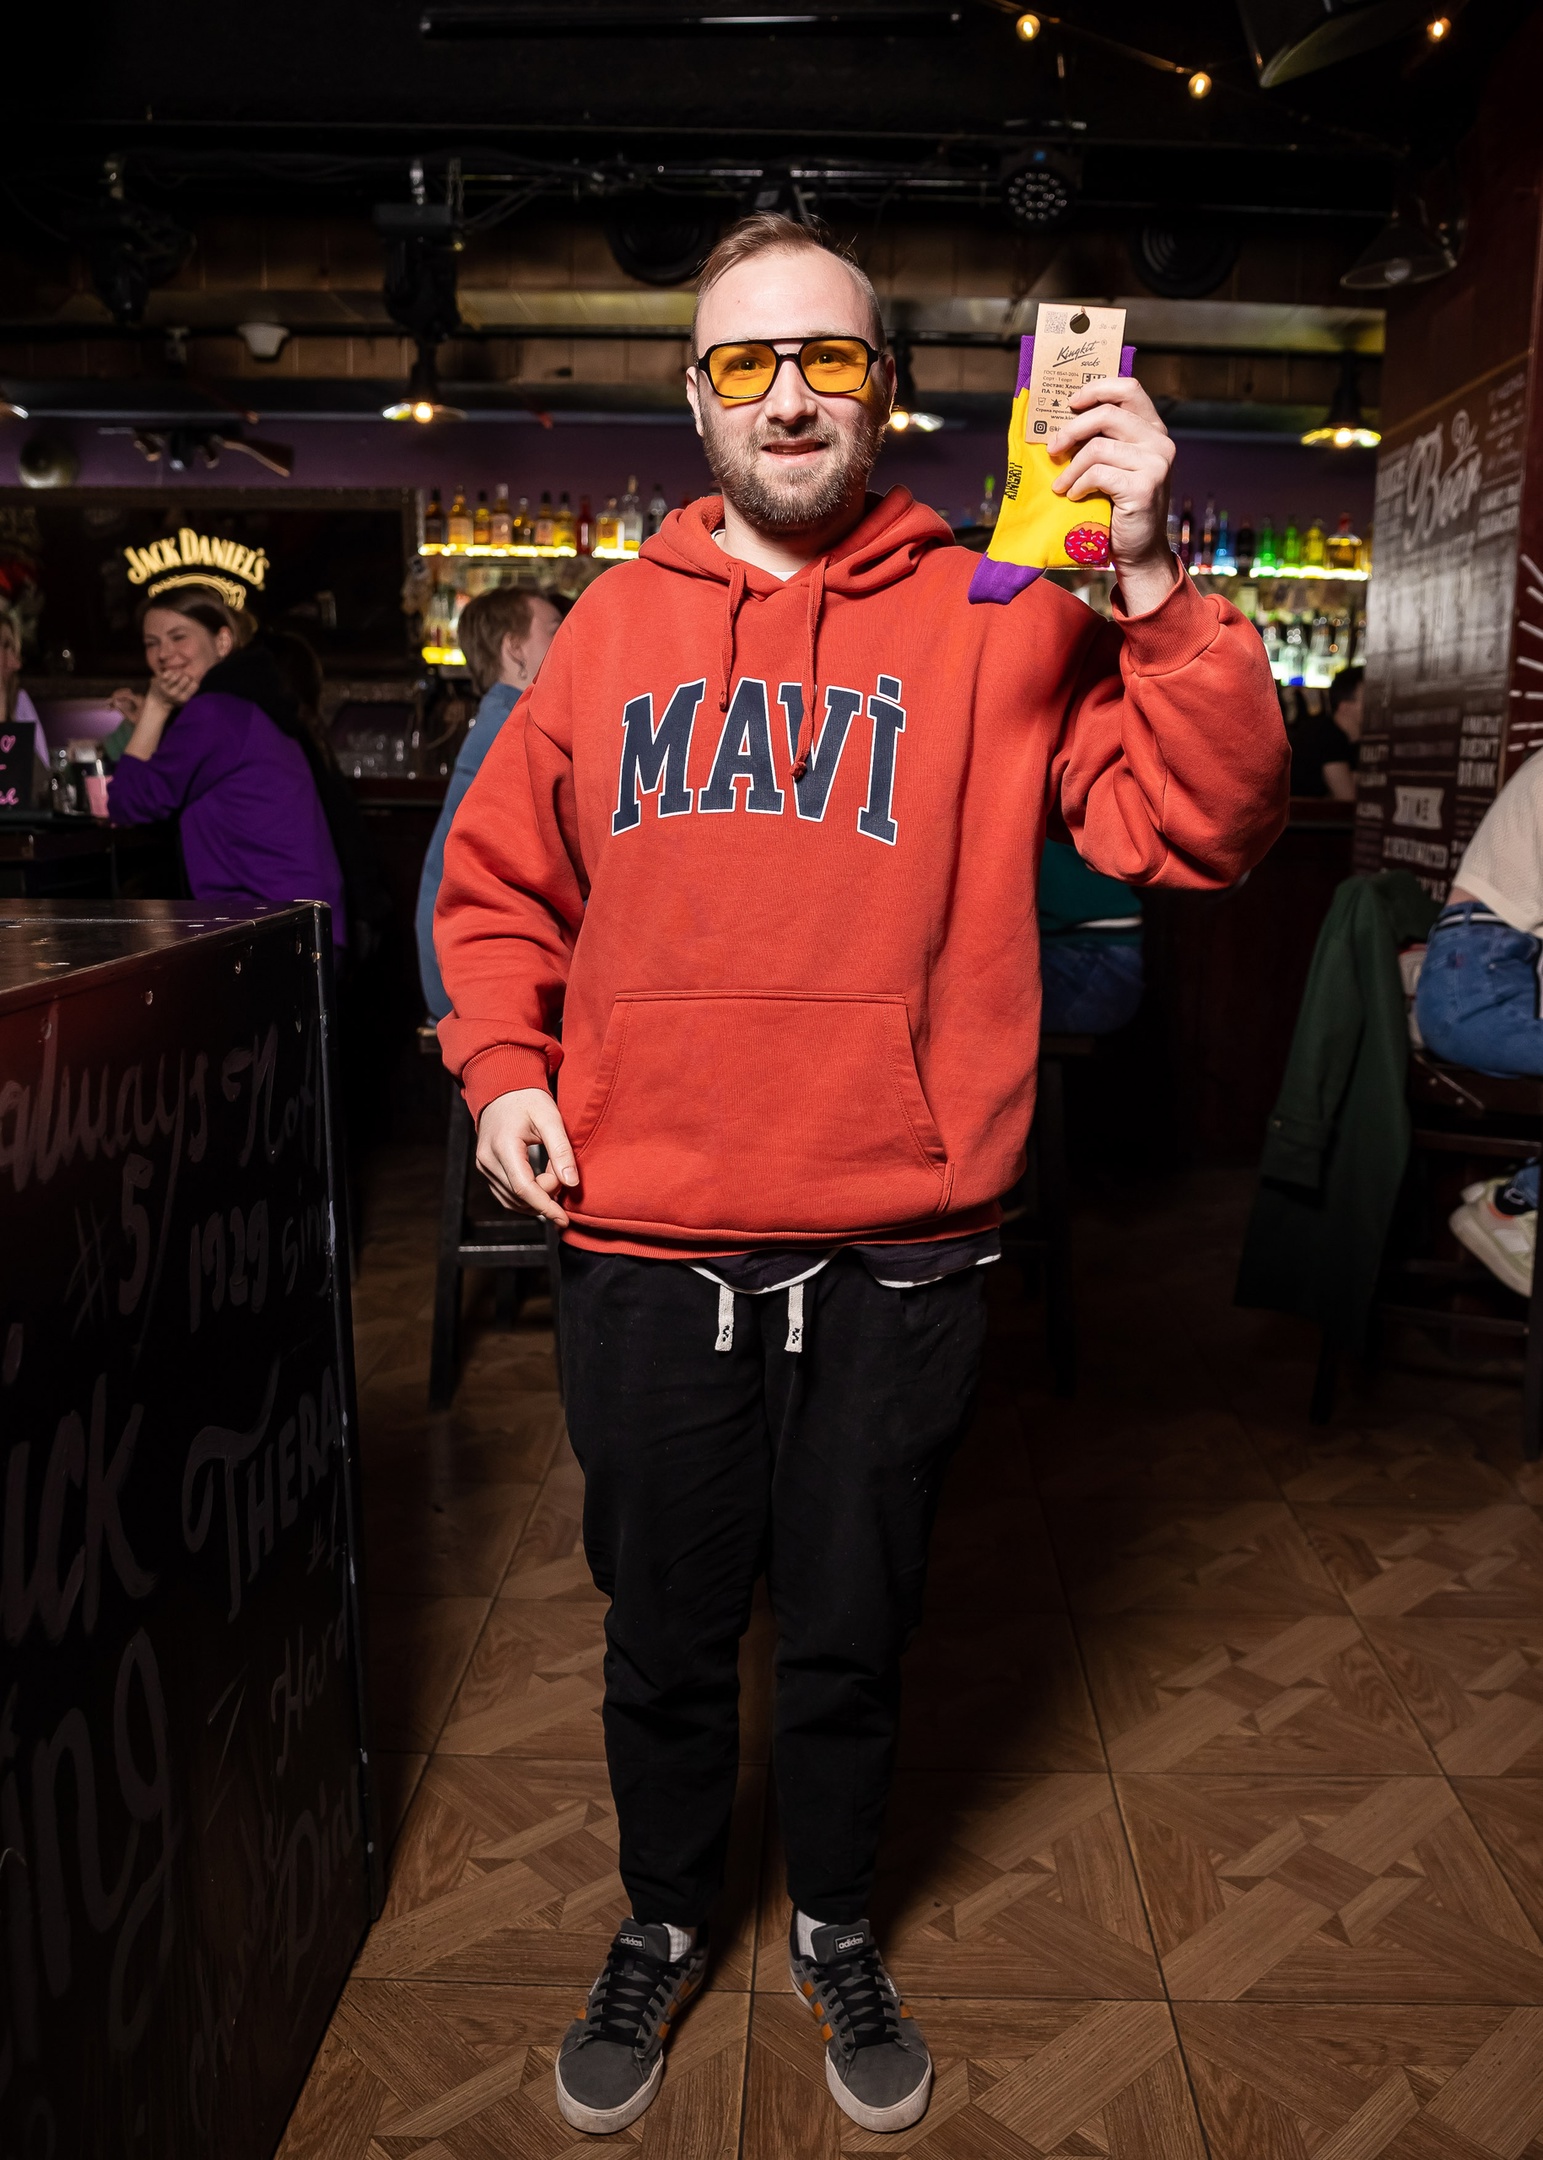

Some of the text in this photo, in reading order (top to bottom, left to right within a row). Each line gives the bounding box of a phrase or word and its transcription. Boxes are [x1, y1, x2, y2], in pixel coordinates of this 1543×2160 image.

[1057, 340, 1099, 361] Kingkit
[1081, 357, 1101, 368] socks
[1402, 421, 1482, 553] Beer
[124, 527, 270, 587] JACK DANIEL'S
[188, 1197, 269, 1334] 1929
[620, 1936, 643, 1947] adidas
[838, 1937, 864, 1949] adidas
